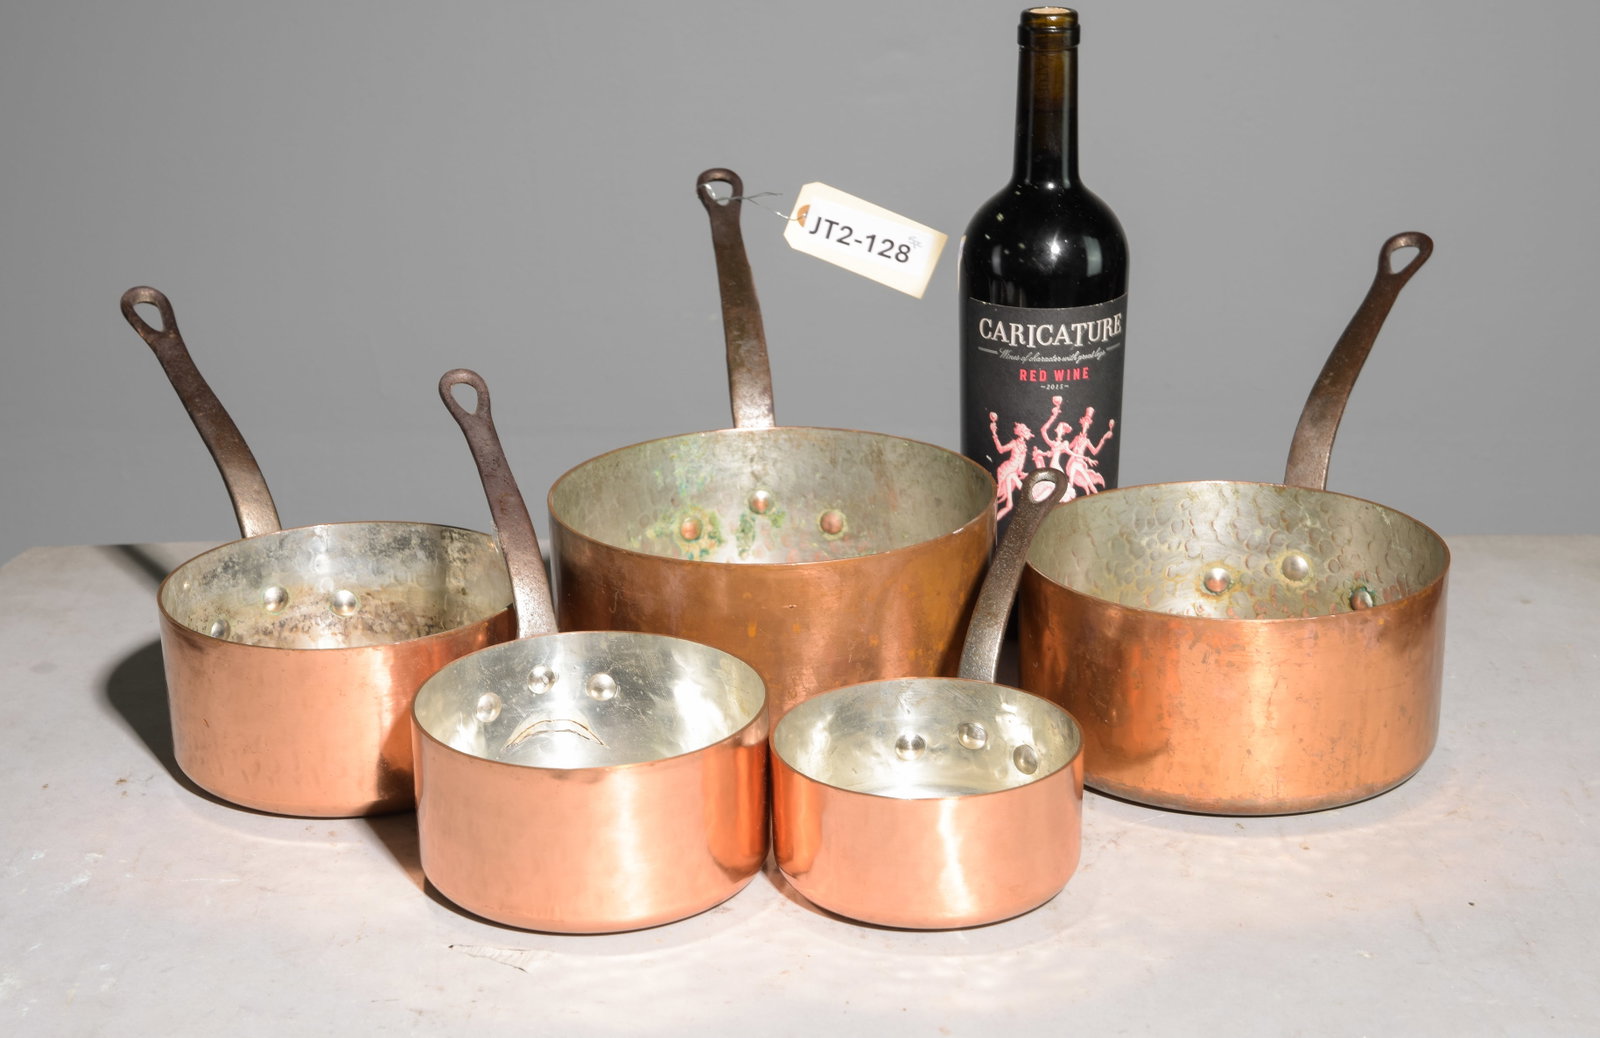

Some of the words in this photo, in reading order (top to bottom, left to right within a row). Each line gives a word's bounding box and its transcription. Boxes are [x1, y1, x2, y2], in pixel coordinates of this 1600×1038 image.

[809, 217, 911, 263] JT2-128
[979, 313, 1122, 348] CARICATURE
[1019, 368, 1047, 382] RED
[1053, 366, 1089, 381] WINE
